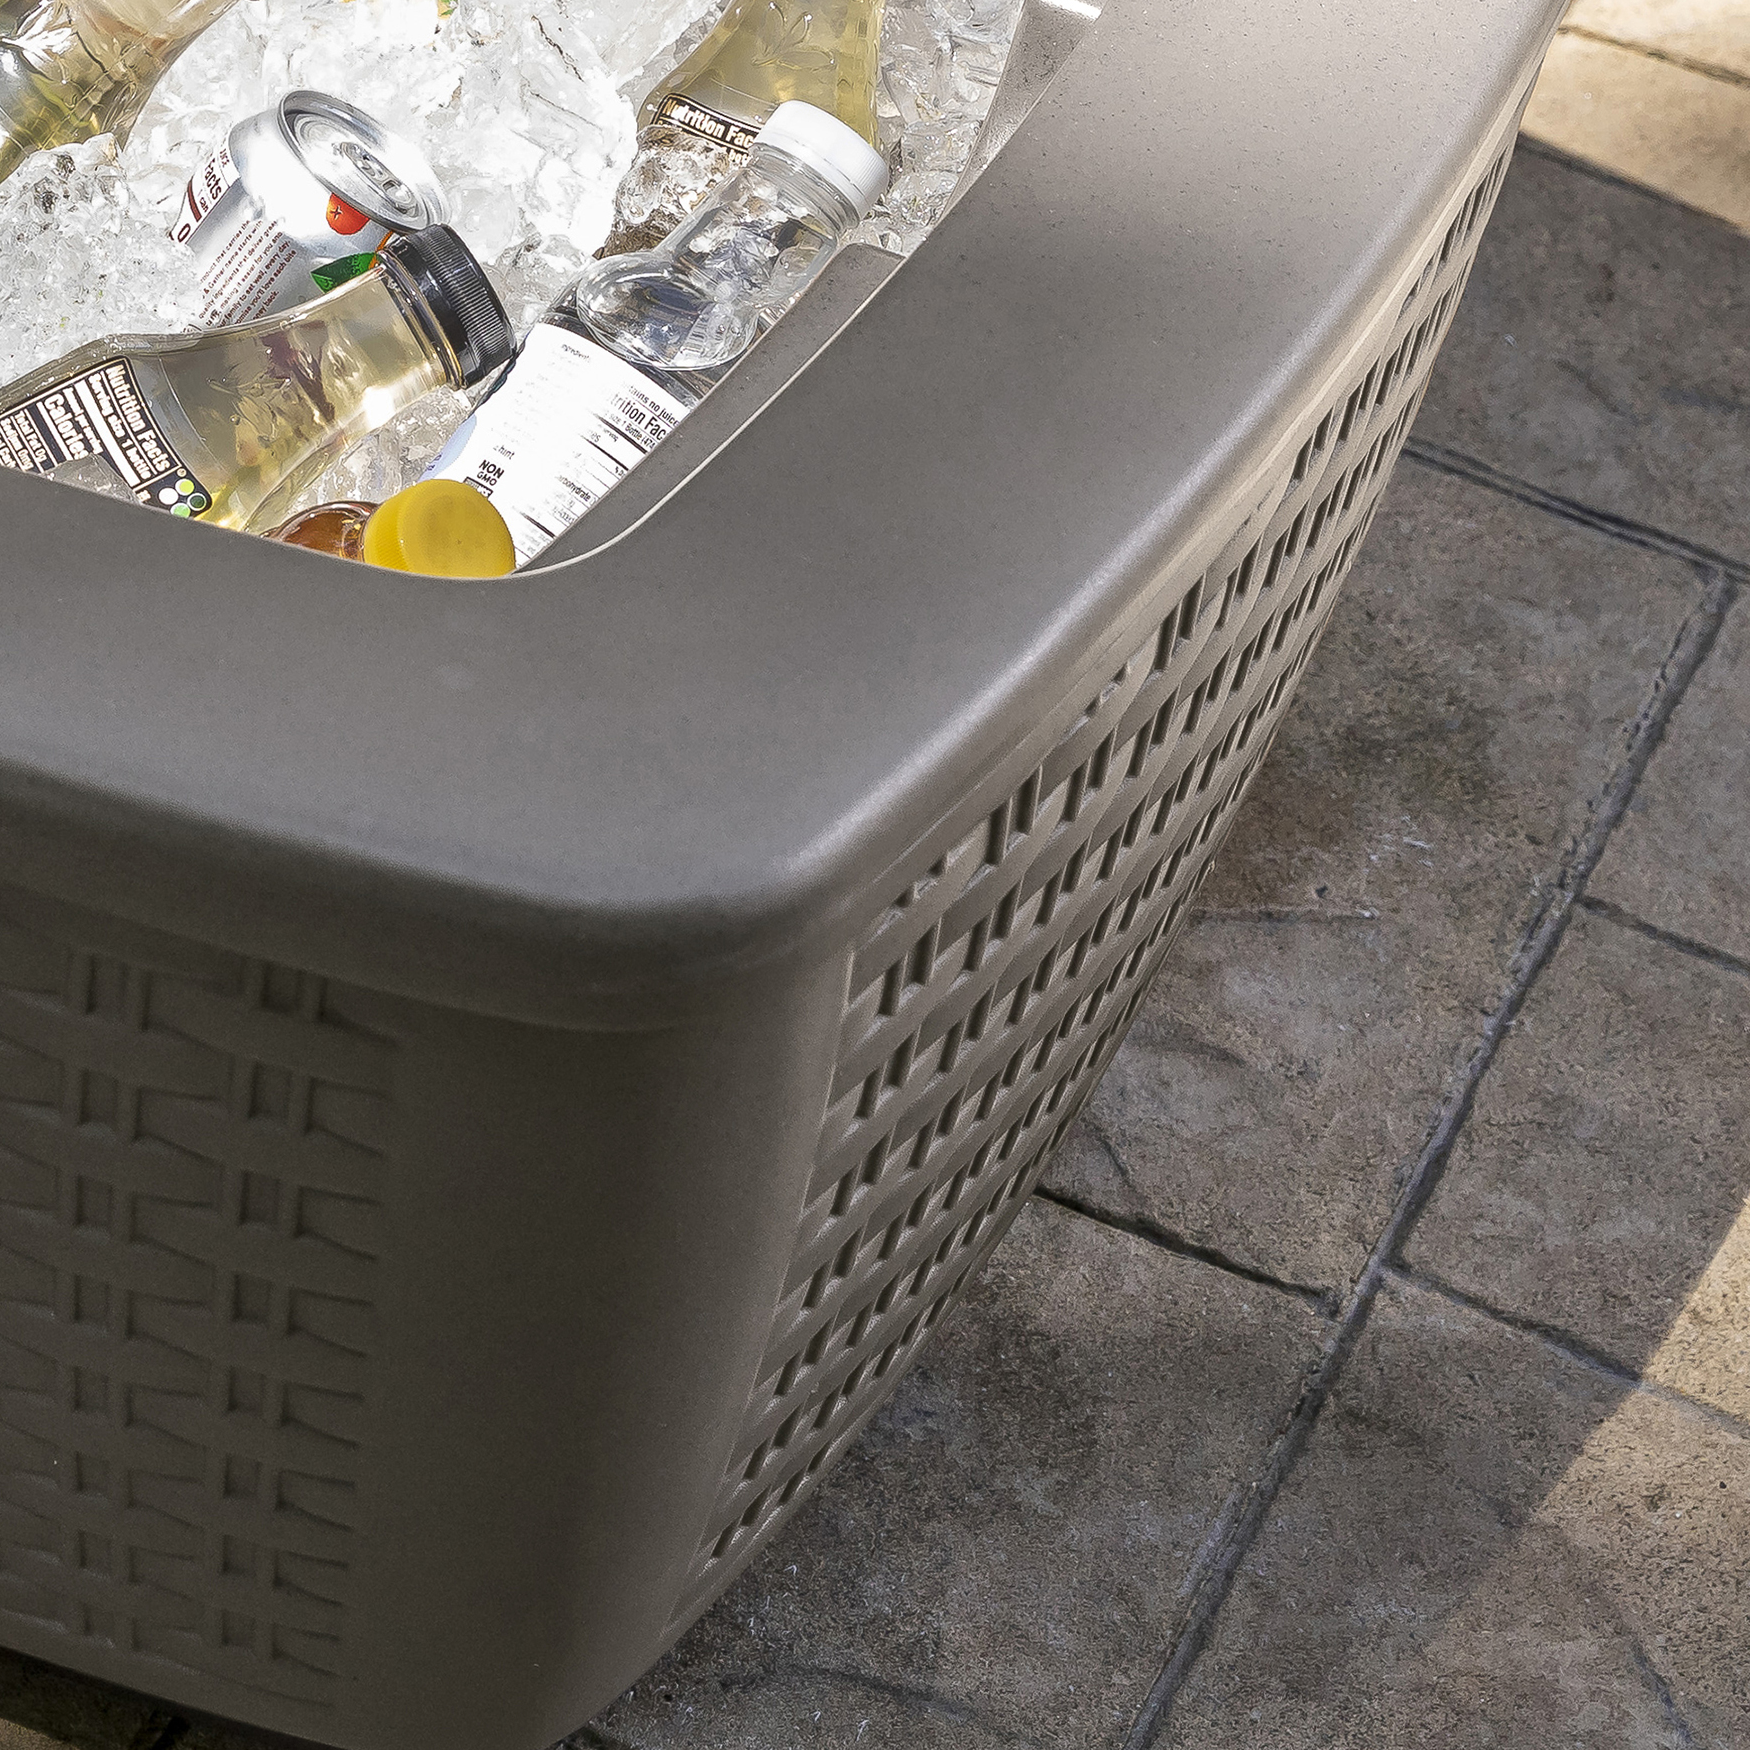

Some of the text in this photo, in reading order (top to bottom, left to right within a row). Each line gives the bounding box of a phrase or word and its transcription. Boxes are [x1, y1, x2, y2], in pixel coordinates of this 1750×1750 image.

[662, 99, 754, 148] Nutrition Fac
[199, 197, 209, 212] can
[216, 250, 226, 266] that
[226, 230, 242, 251] carries
[225, 251, 239, 268] name
[238, 234, 252, 252] starts
[262, 276, 276, 292] love
[273, 262, 287, 278] each
[284, 249, 297, 263] bite
[199, 300, 215, 319] quality
[213, 268, 240, 299] ingredients
[247, 235, 265, 256] deliver
[220, 287, 238, 310] making
[254, 254, 264, 265] for
[263, 243, 273, 257] you
[224, 300, 242, 320] family
[240, 293, 247, 302] to
[245, 284, 255, 295] eat
[253, 269, 267, 285] well,
[264, 252, 281, 270] every
[88, 373, 115, 417] Serving
[107, 414, 126, 438] size
[121, 438, 133, 449] 1
[105, 364, 170, 472] Nutrition Facts
[610, 392, 667, 441] trition Fac
[628, 385, 650, 404] tains
[648, 400, 661, 412] no
[15, 410, 47, 462] Total Fat 0g
[43, 393, 89, 460] Calories
[625, 421, 643, 440] Bottle
[17, 449, 34, 470] 0mg
[476, 471, 498, 487] GMO
[479, 459, 505, 479] NON
